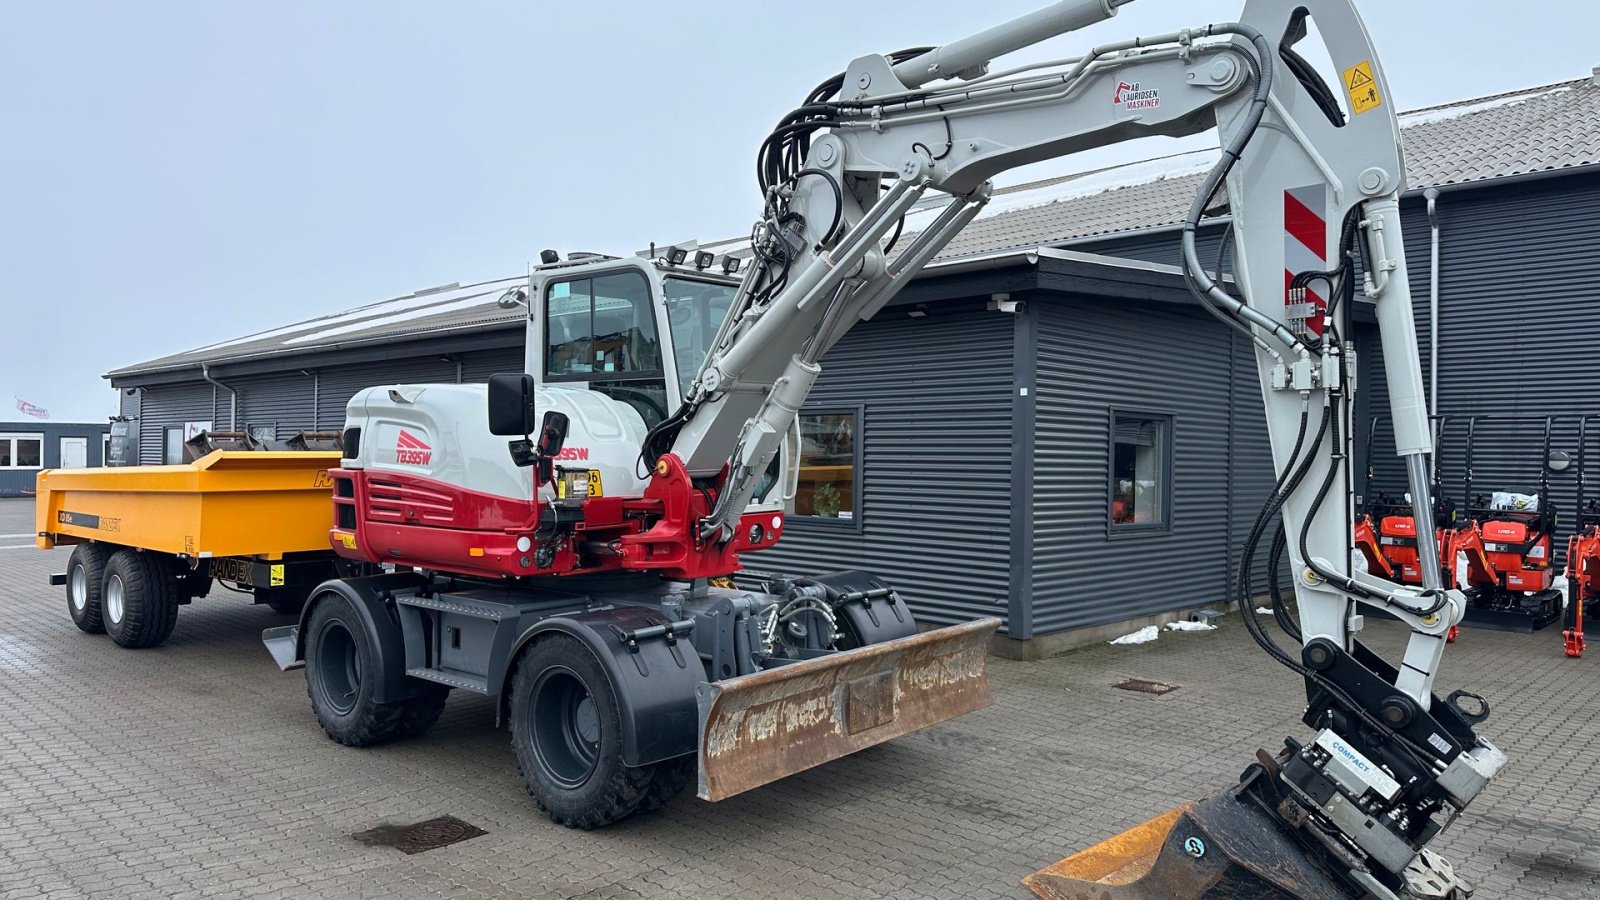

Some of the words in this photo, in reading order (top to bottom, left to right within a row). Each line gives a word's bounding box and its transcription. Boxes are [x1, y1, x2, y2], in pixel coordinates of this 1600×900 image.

[1131, 83, 1140, 92] AB
[1123, 90, 1158, 102] LAURIDSEN
[1127, 98, 1160, 110] MASKINER
[396, 449, 432, 465] TB395W
[208, 557, 254, 586] RANDEX
[1332, 741, 1370, 773] COMPACT
